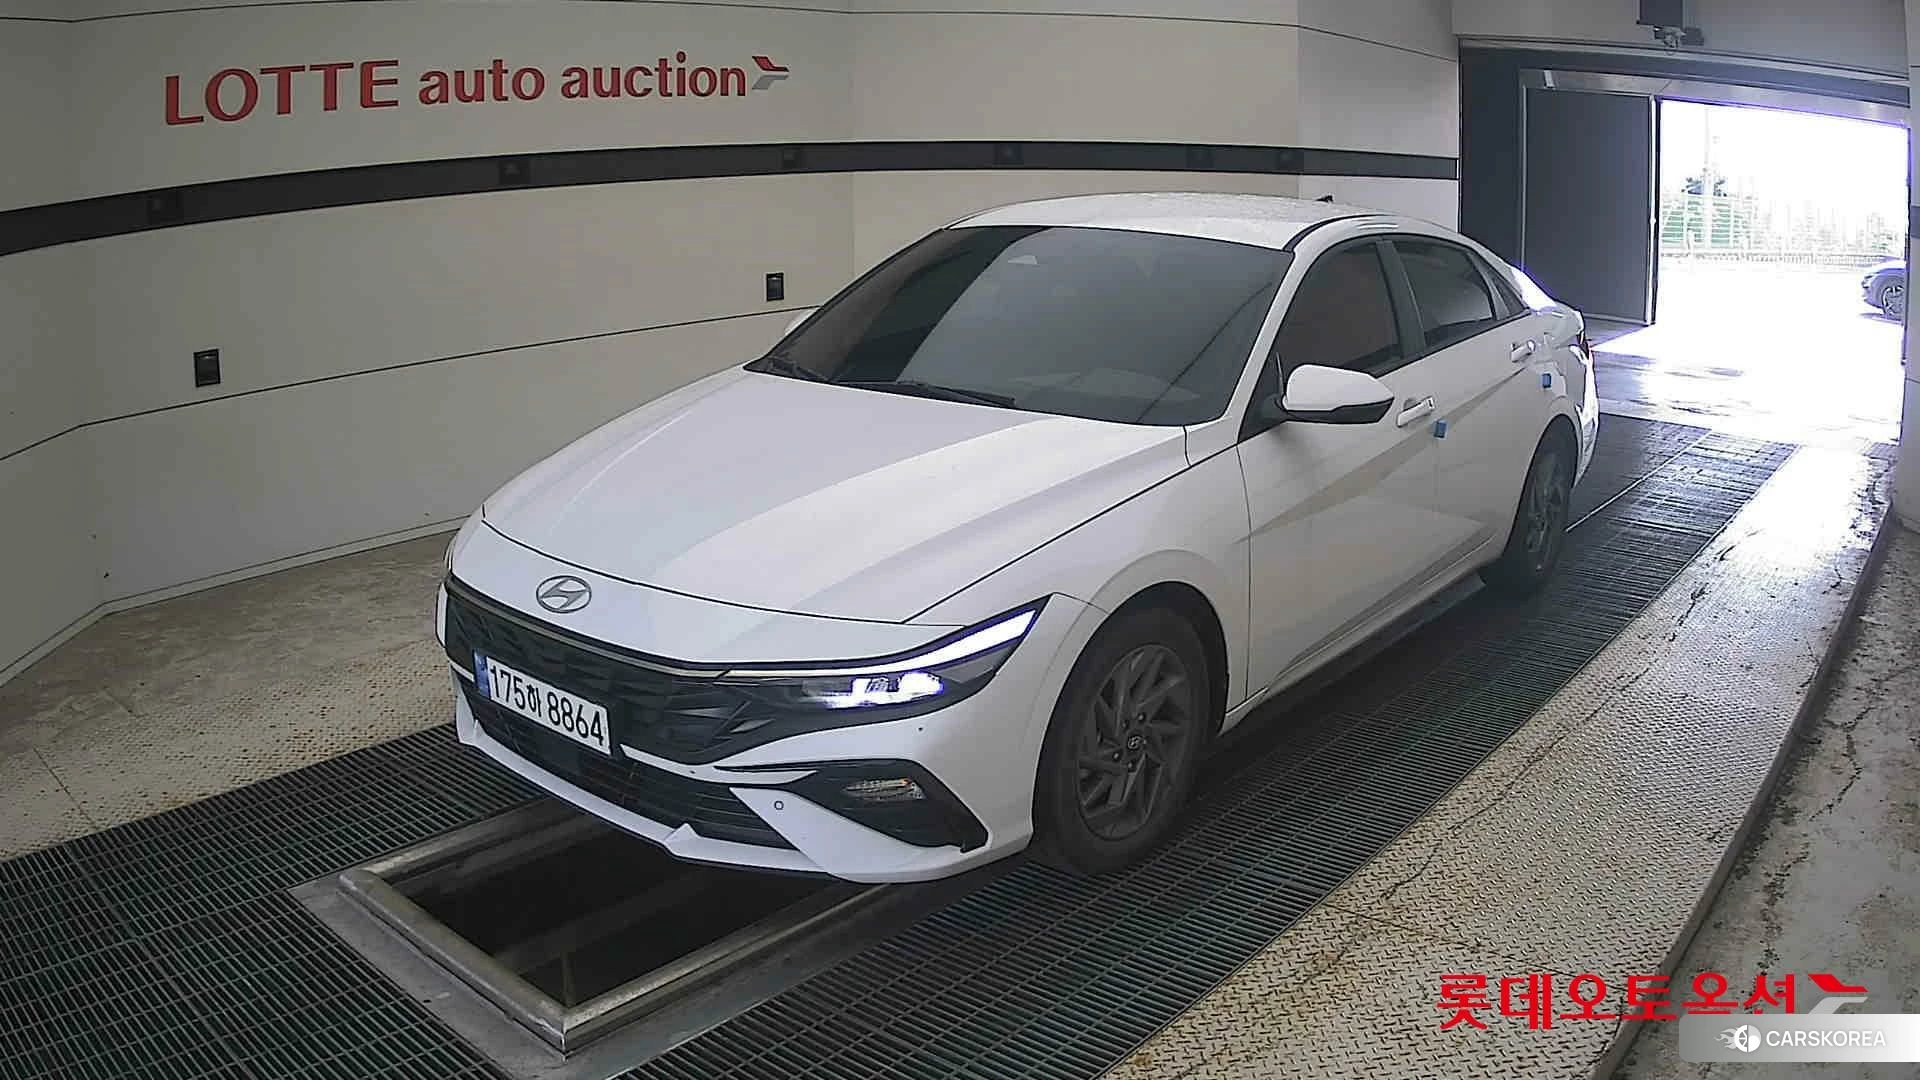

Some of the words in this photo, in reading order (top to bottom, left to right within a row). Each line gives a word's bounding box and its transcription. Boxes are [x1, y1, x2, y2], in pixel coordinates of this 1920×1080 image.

[165, 59, 400, 126] LOTTE
[418, 58, 545, 105] auto
[561, 51, 747, 99] auction
[547, 691, 604, 746] 8864
